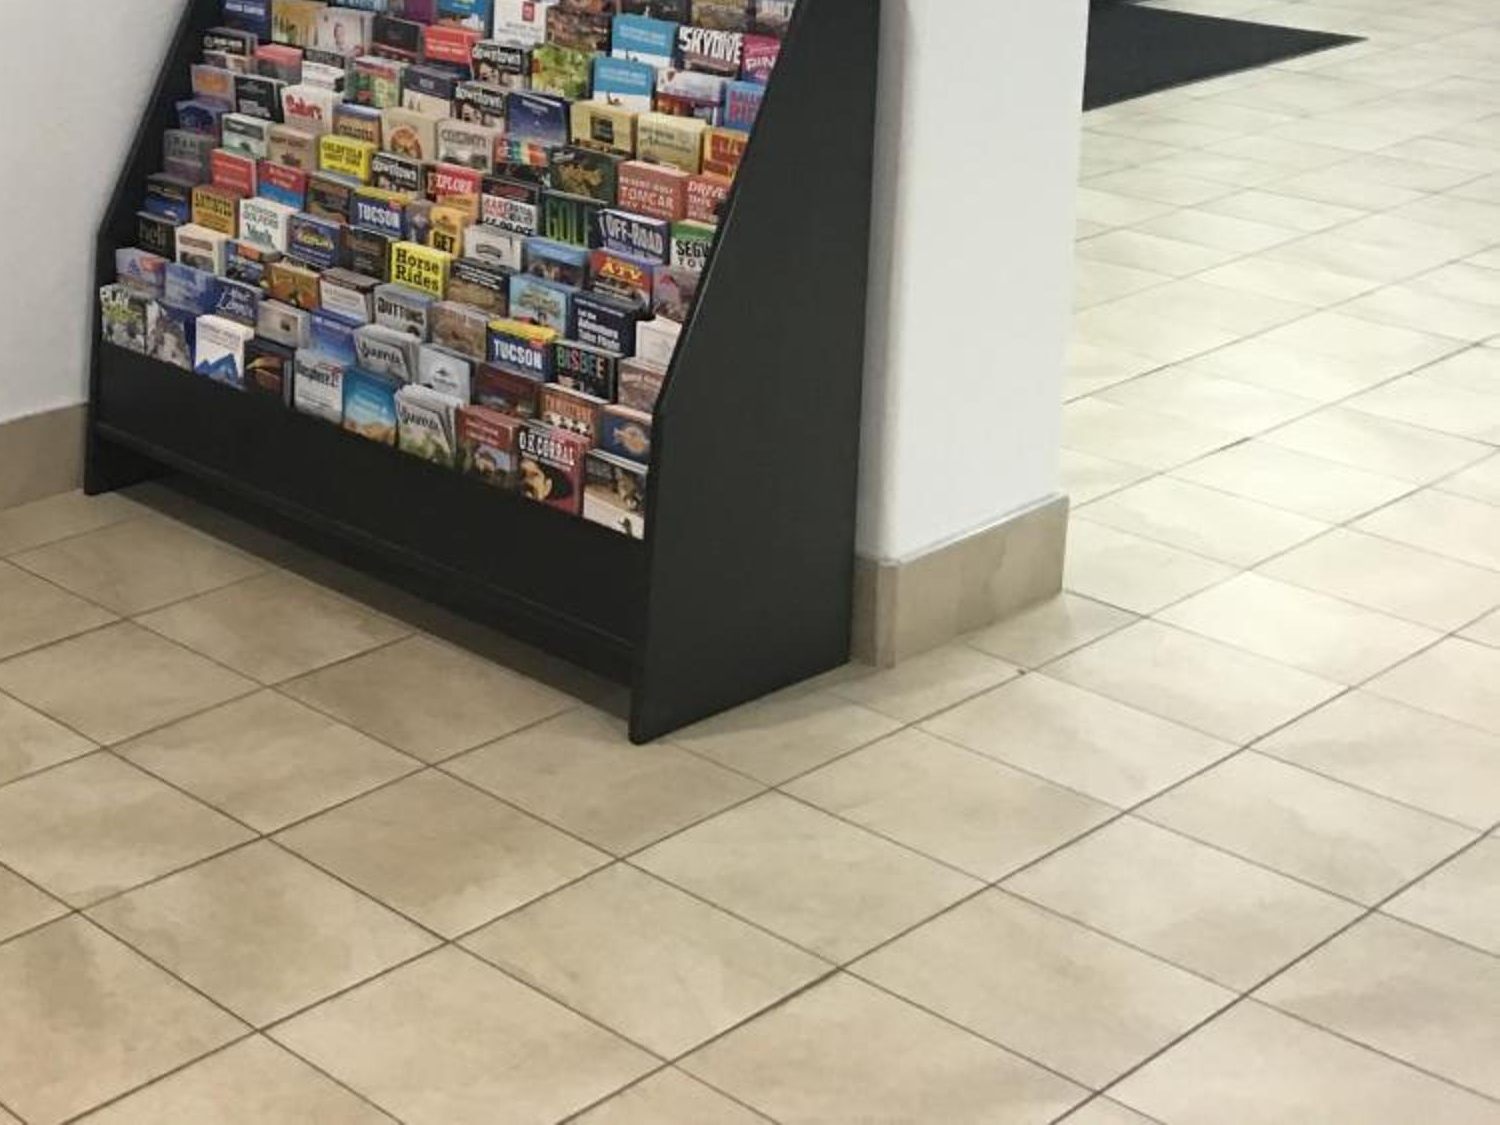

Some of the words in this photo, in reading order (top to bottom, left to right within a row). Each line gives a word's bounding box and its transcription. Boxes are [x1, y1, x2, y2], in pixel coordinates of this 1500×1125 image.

[679, 26, 743, 64] SKYDIVE
[358, 202, 401, 229] TUCSON
[433, 230, 455, 254] GET
[396, 249, 440, 274] Horse
[396, 264, 440, 291] Rides
[493, 340, 543, 369] TUCSON
[557, 346, 605, 380] BISBEE
